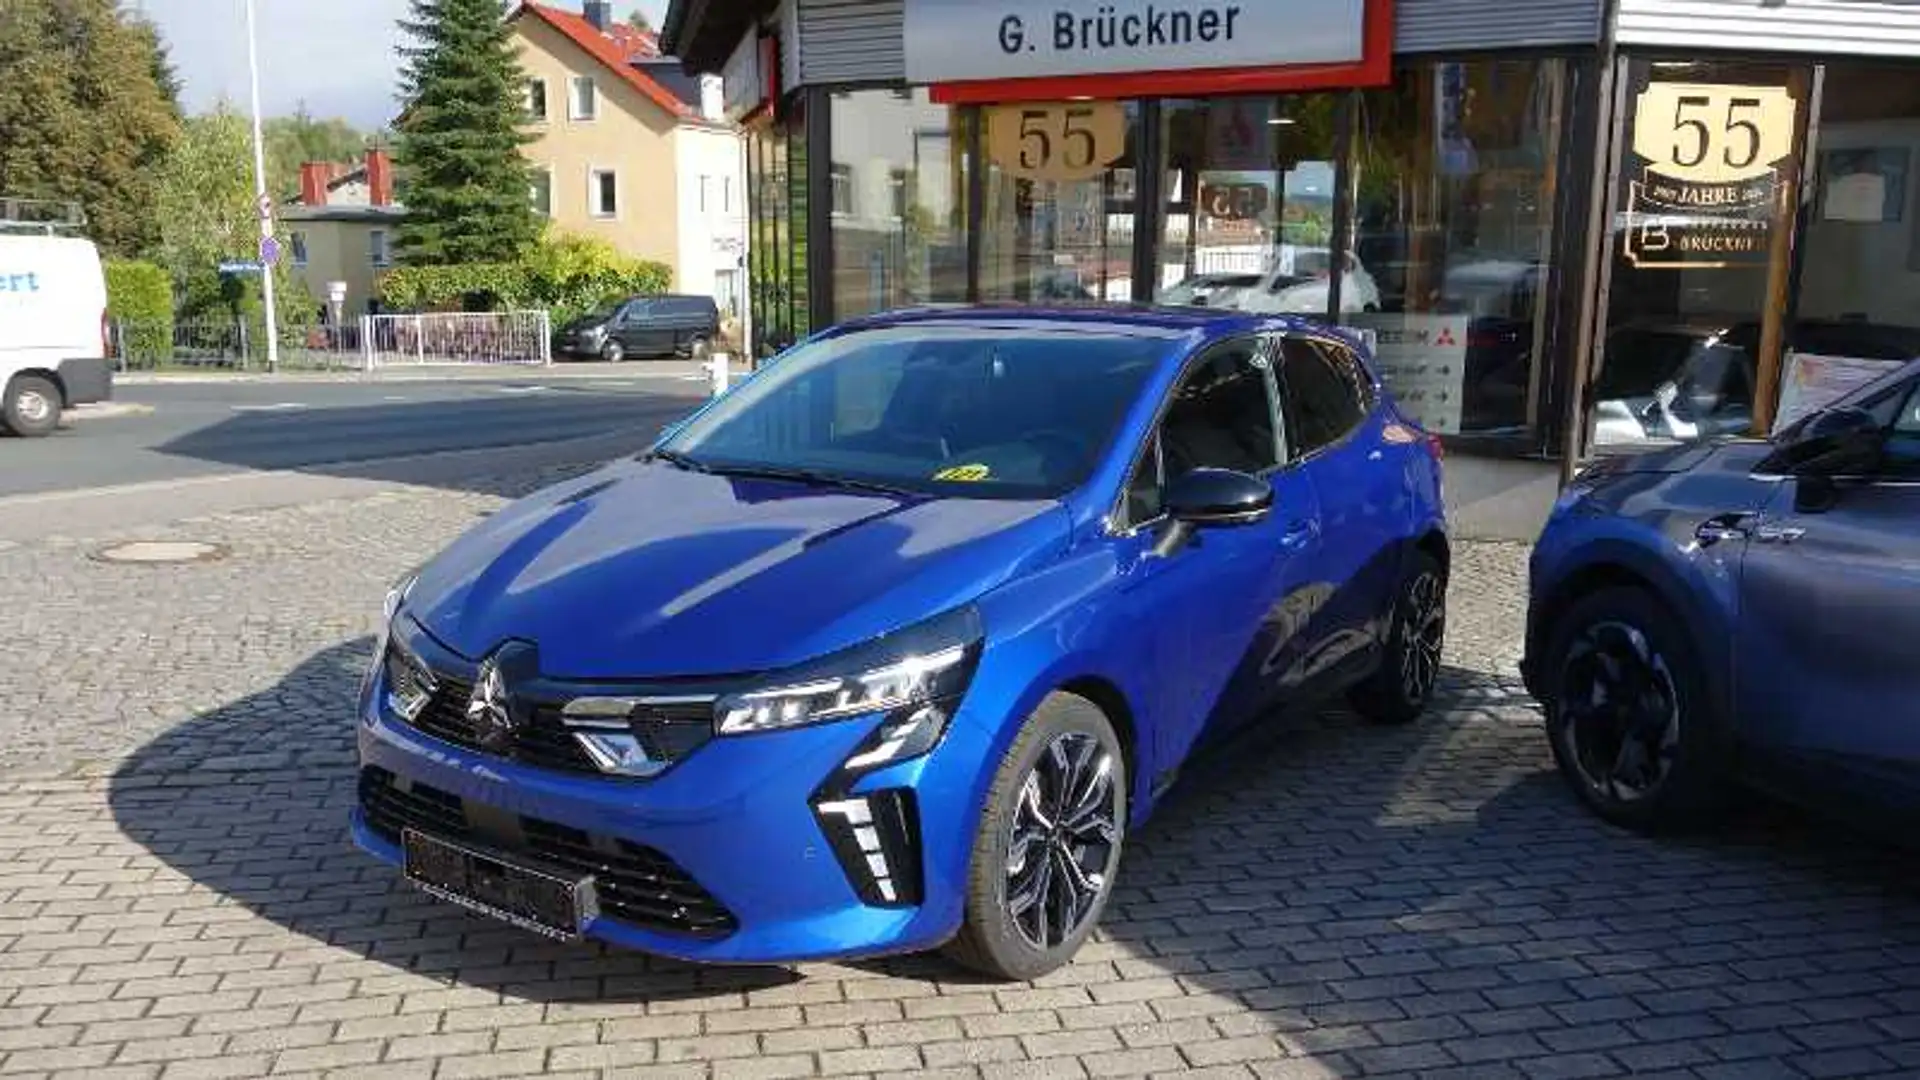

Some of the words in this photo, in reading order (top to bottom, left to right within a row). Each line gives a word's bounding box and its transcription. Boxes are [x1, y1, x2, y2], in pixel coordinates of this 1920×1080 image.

[999, 15, 1036, 54] G.
[1053, 6, 1240, 50] Brückner
[1019, 109, 1096, 170] 55
[1672, 96, 1761, 168] 55
[1677, 186, 1737, 203] JAHRE
